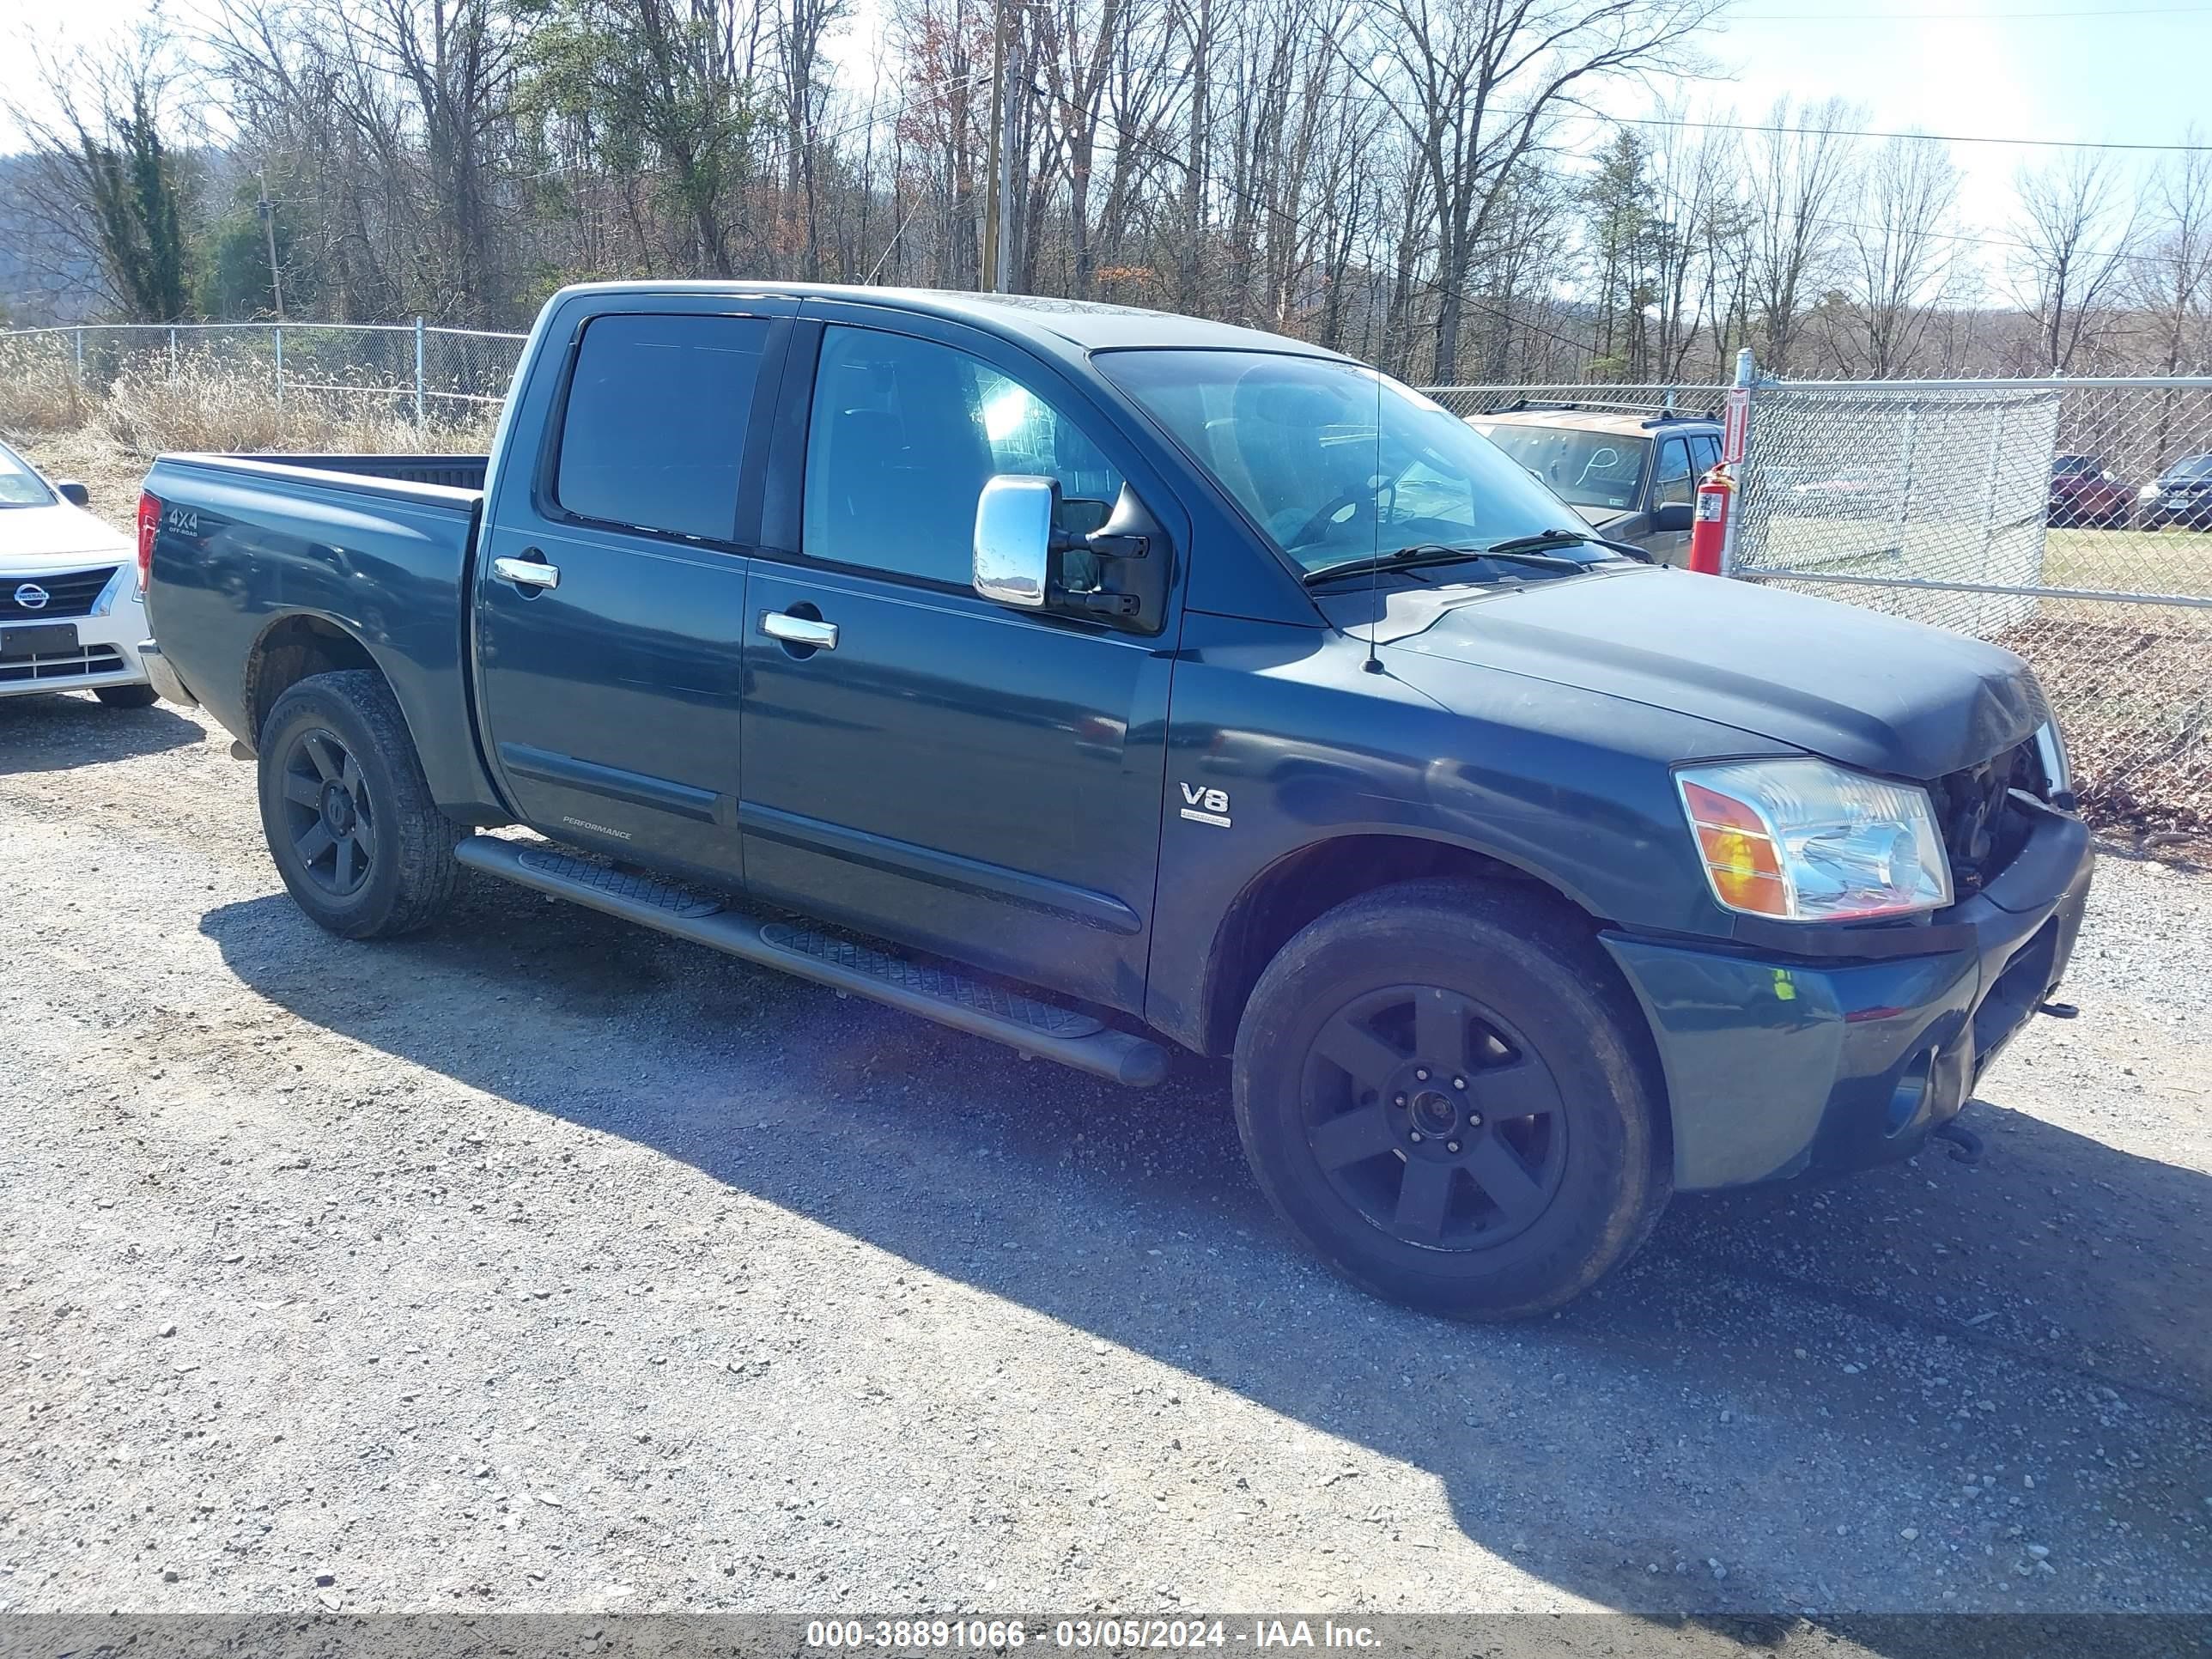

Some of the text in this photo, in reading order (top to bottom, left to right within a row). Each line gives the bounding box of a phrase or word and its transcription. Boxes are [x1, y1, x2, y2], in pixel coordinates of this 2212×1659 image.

[1575, 447, 1619, 486] P
[168, 526, 198, 538] OFF-ROAD
[1180, 782, 1229, 812] V8
[562, 816, 632, 840] PERFORMANCE
